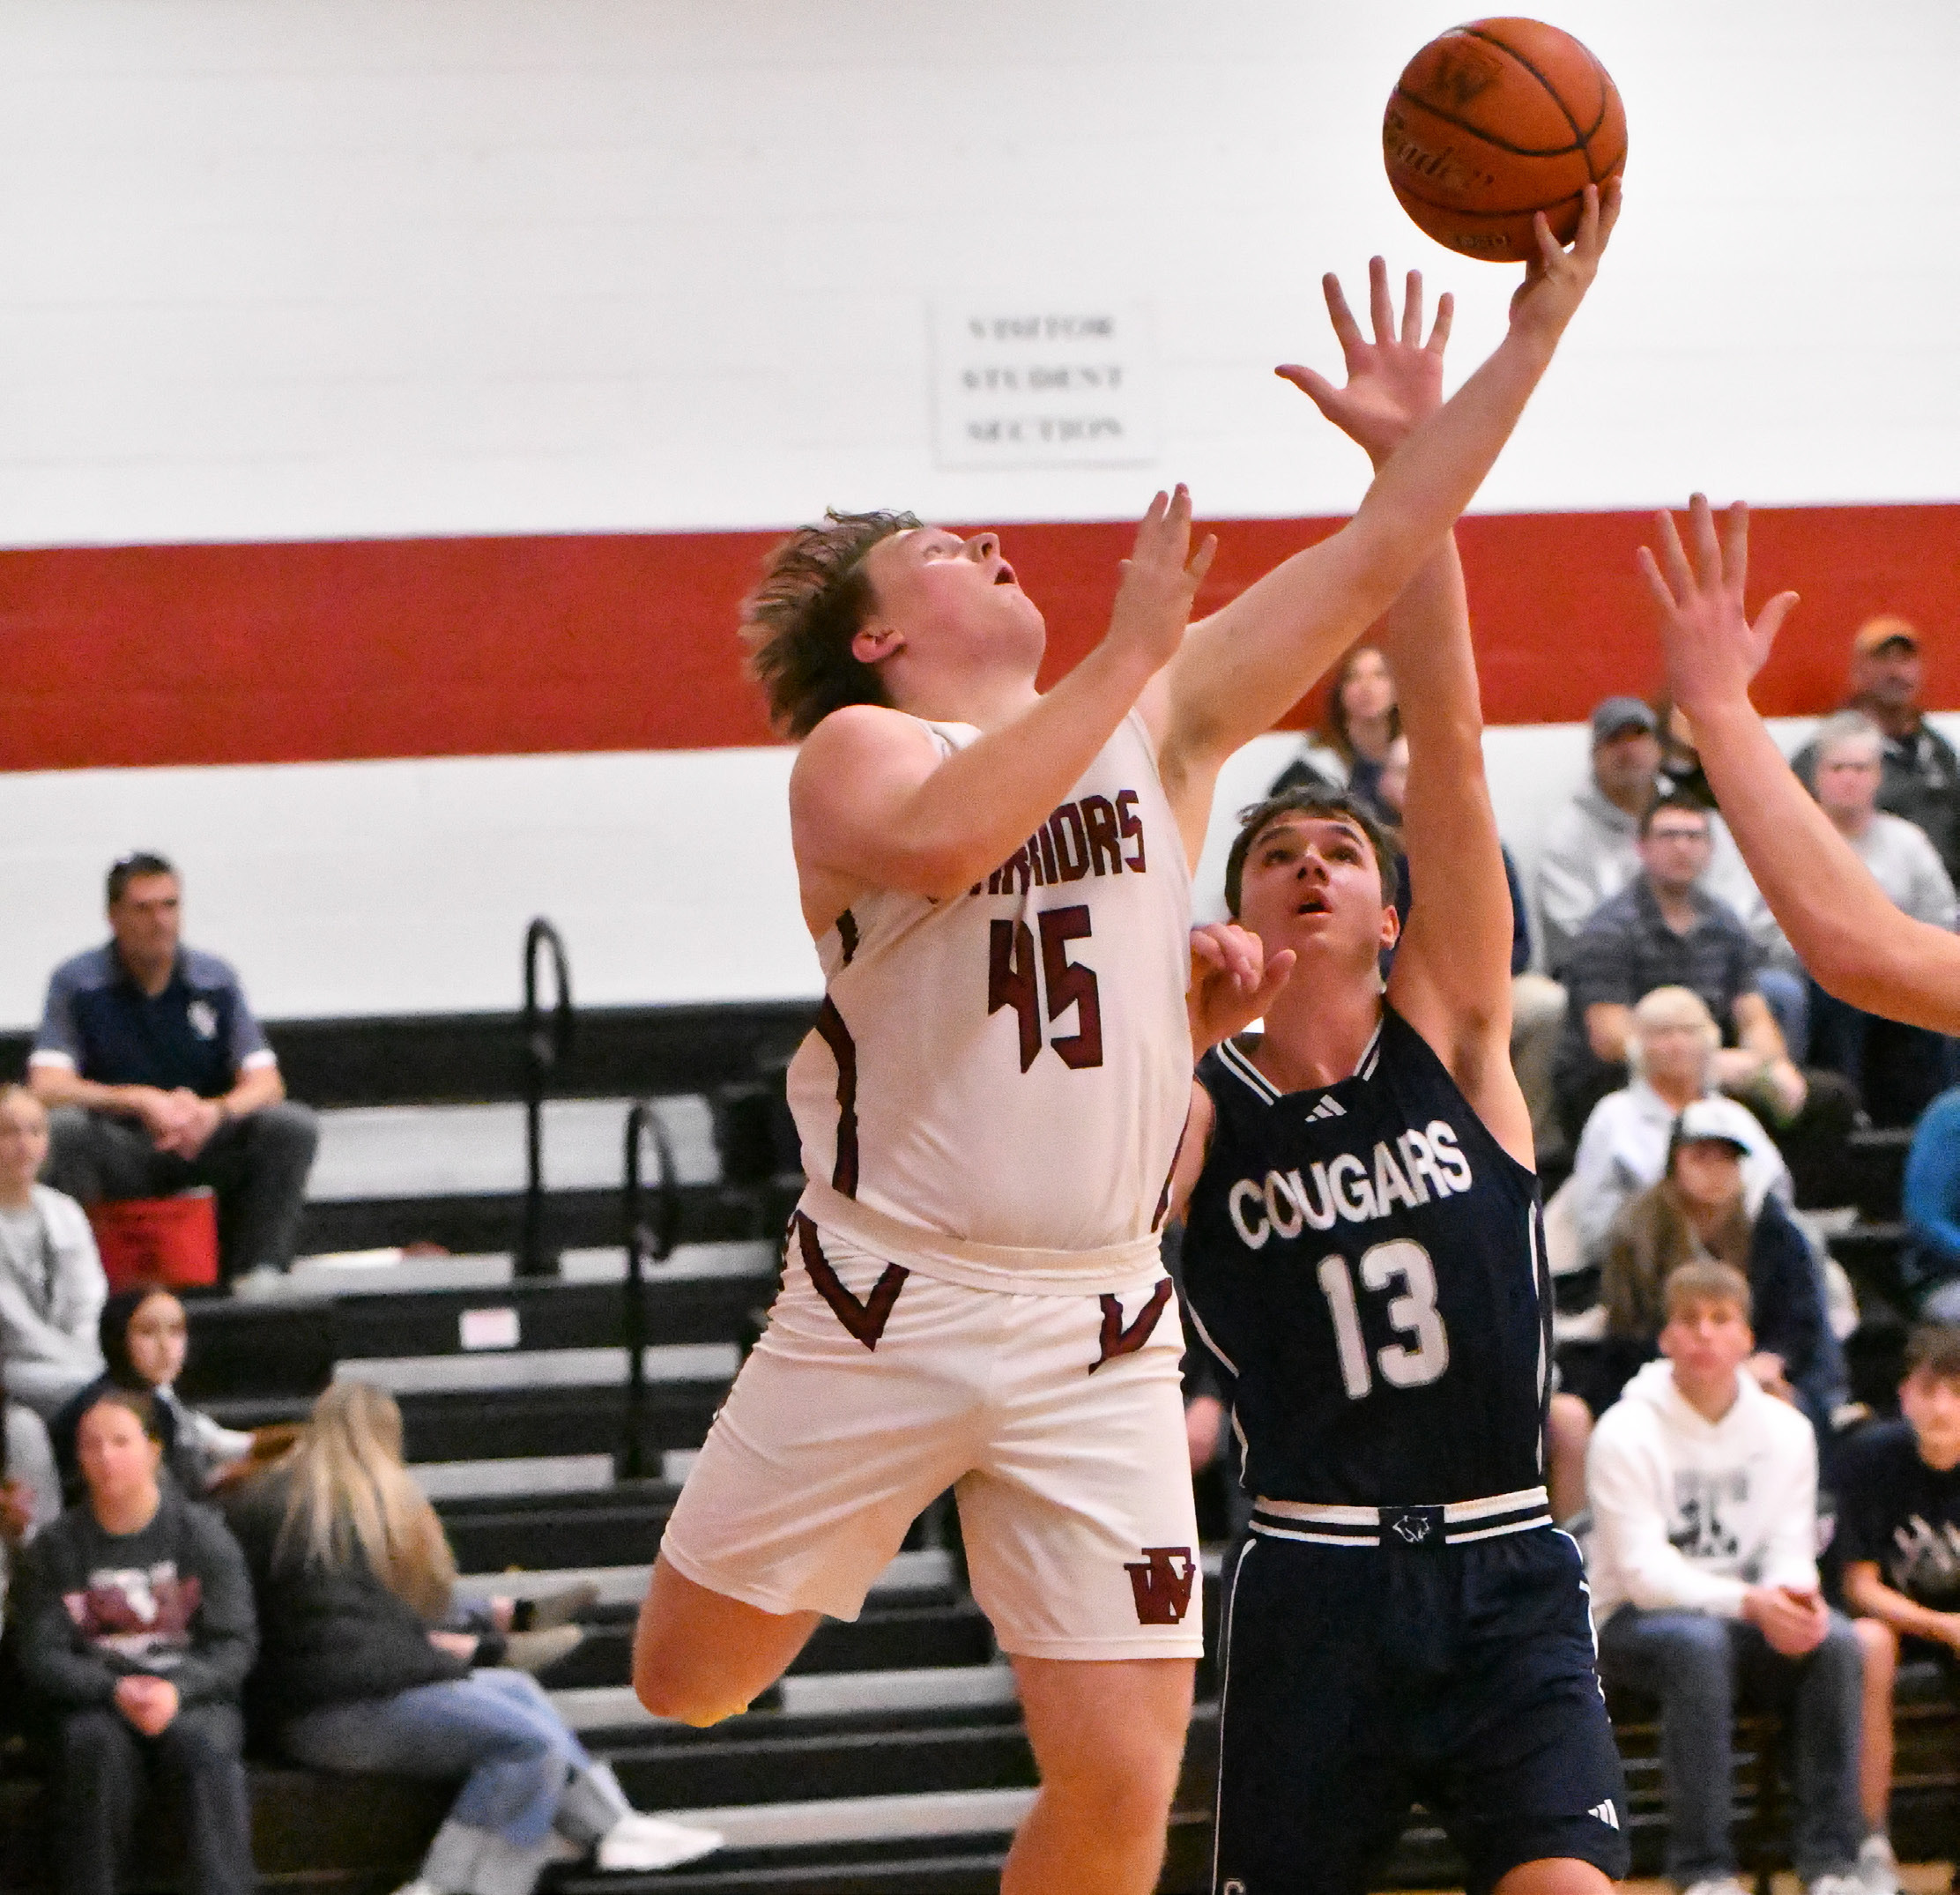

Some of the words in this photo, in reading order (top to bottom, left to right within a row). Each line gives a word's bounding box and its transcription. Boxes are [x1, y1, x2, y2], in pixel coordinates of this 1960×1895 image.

[959, 362, 1124, 393] STUDENT
[987, 904, 1103, 1074] 45
[1229, 1119, 1474, 1251] COUGARS
[1316, 1237, 1451, 1401] 13
